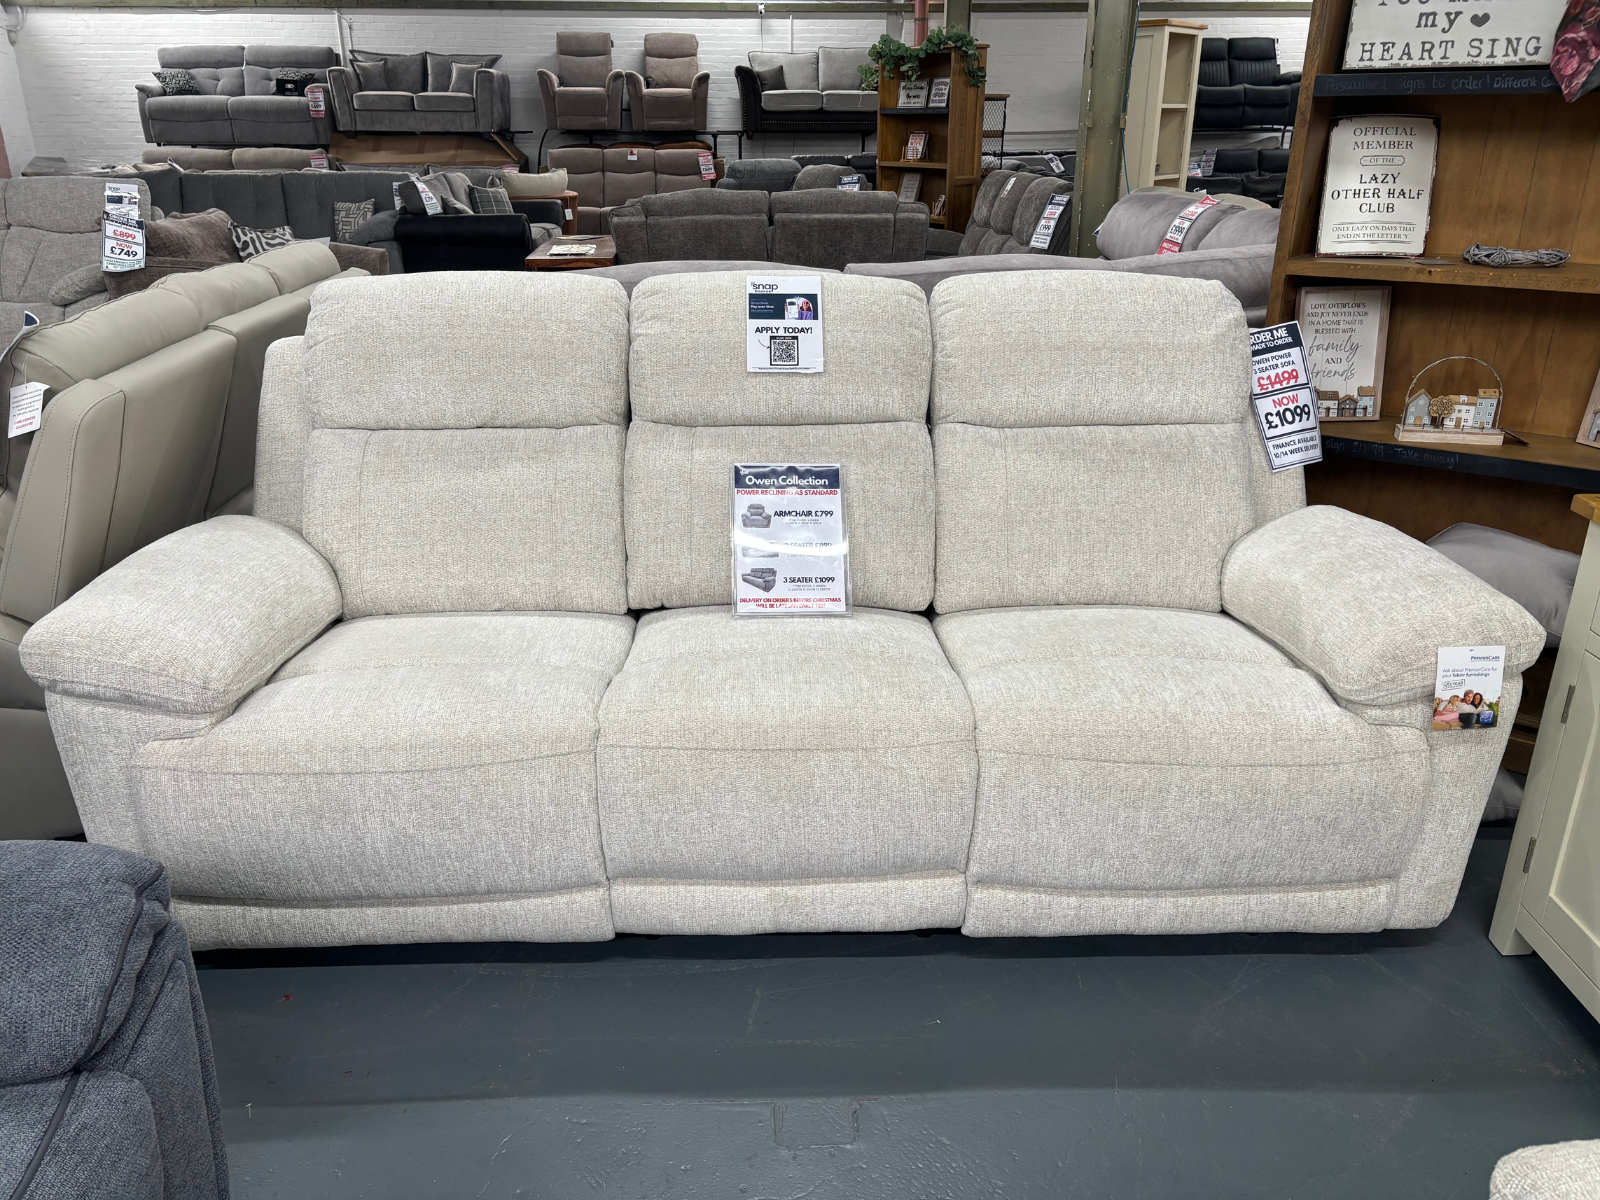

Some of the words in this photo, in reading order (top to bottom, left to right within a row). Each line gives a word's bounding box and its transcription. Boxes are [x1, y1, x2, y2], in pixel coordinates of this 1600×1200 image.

[1415, 11, 1464, 34] my
[1358, 40, 1455, 62] HEART
[1466, 36, 1543, 58] SING
[1396, 77, 1426, 92] signs
[1432, 76, 1446, 88] to
[1452, 76, 1490, 90] order!
[1494, 74, 1537, 88] Different
[1353, 126, 1416, 136] OFFICIAL
[1352, 140, 1414, 150] MEMBER
[1359, 172, 1401, 184] LAZY
[1331, 188, 1381, 200] OTHER
[1386, 188, 1424, 200] HALF
[1359, 202, 1395, 213] CLUB
[113, 229, 136, 240] £899
[110, 246, 138, 258] £749
[752, 284, 778, 292] snap
[1250, 332, 1273, 344] RDER
[1273, 327, 1288, 339] ME
[1251, 342, 1266, 351] MADE
[1274, 337, 1293, 346] ORDER
[1308, 335, 1362, 362] family
[1252, 356, 1270, 366] OWEN
[1271, 352, 1292, 362] POWER
[1259, 364, 1280, 373] SEATER
[1280, 360, 1296, 368] SOFA
[1311, 361, 1356, 382] friends
[1257, 368, 1299, 391] £1499
[1272, 393, 1299, 409] NOW
[1264, 404, 1311, 430] £1099
[1272, 440, 1297, 450] FINANCE
[1298, 435, 1317, 444] AVAILABLE
[1288, 446, 1304, 455] WEEK
[1394, 448, 1420, 461] Take
[1423, 452, 1459, 469] away!
[745, 476, 777, 486] Owen
[779, 475, 829, 486] Collection
